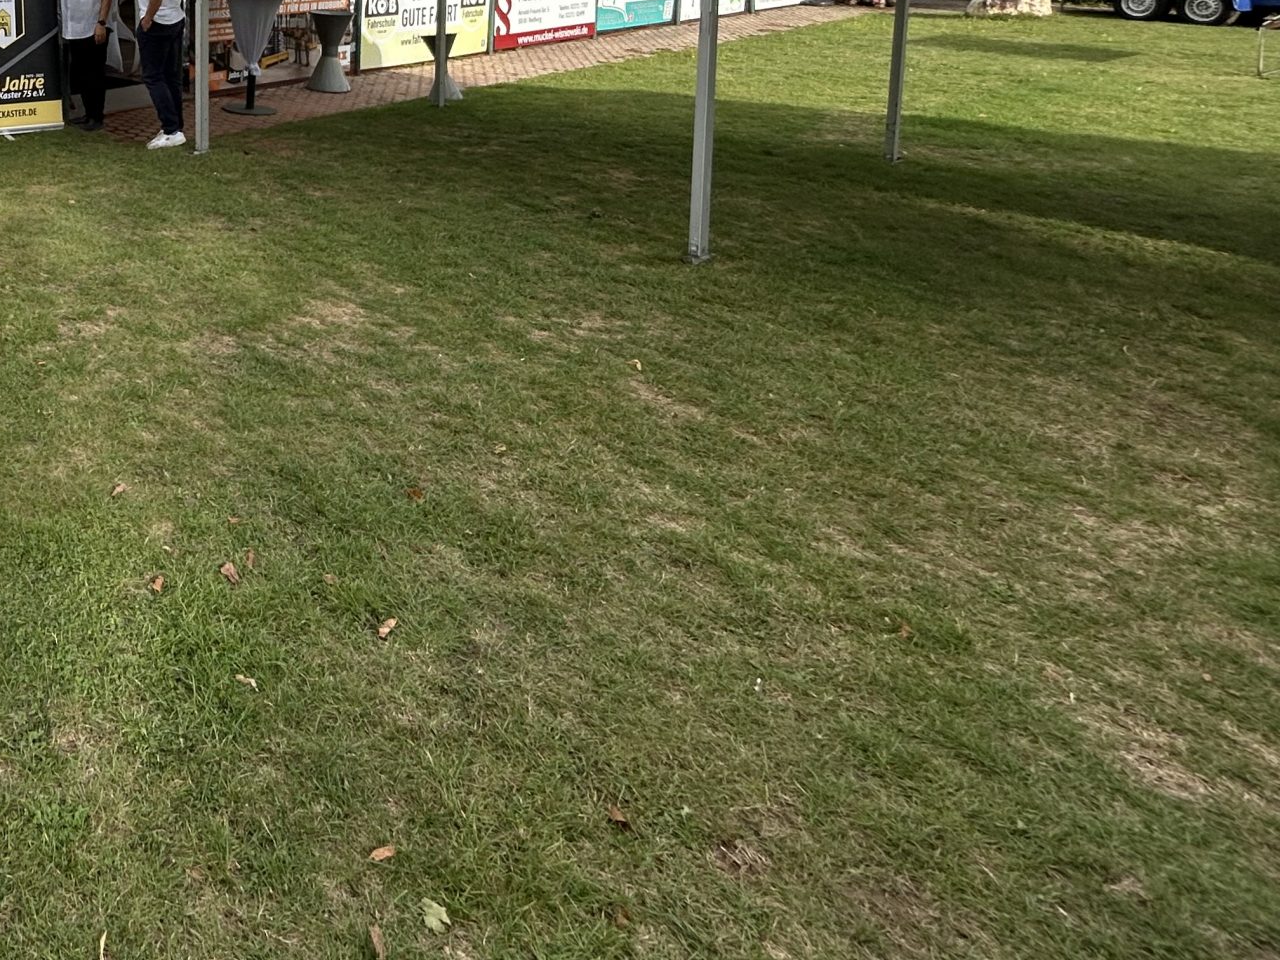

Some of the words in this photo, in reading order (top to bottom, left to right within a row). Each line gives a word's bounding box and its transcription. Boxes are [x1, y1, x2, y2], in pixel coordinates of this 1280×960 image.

[402, 6, 426, 27] GUTE
[429, 4, 458, 25] FRT
[367, 18, 396, 30] Fahrschule
[1, 74, 45, 93] Jahre
[22, 90, 32, 98] 75
[32, 89, 46, 97] e.V.
